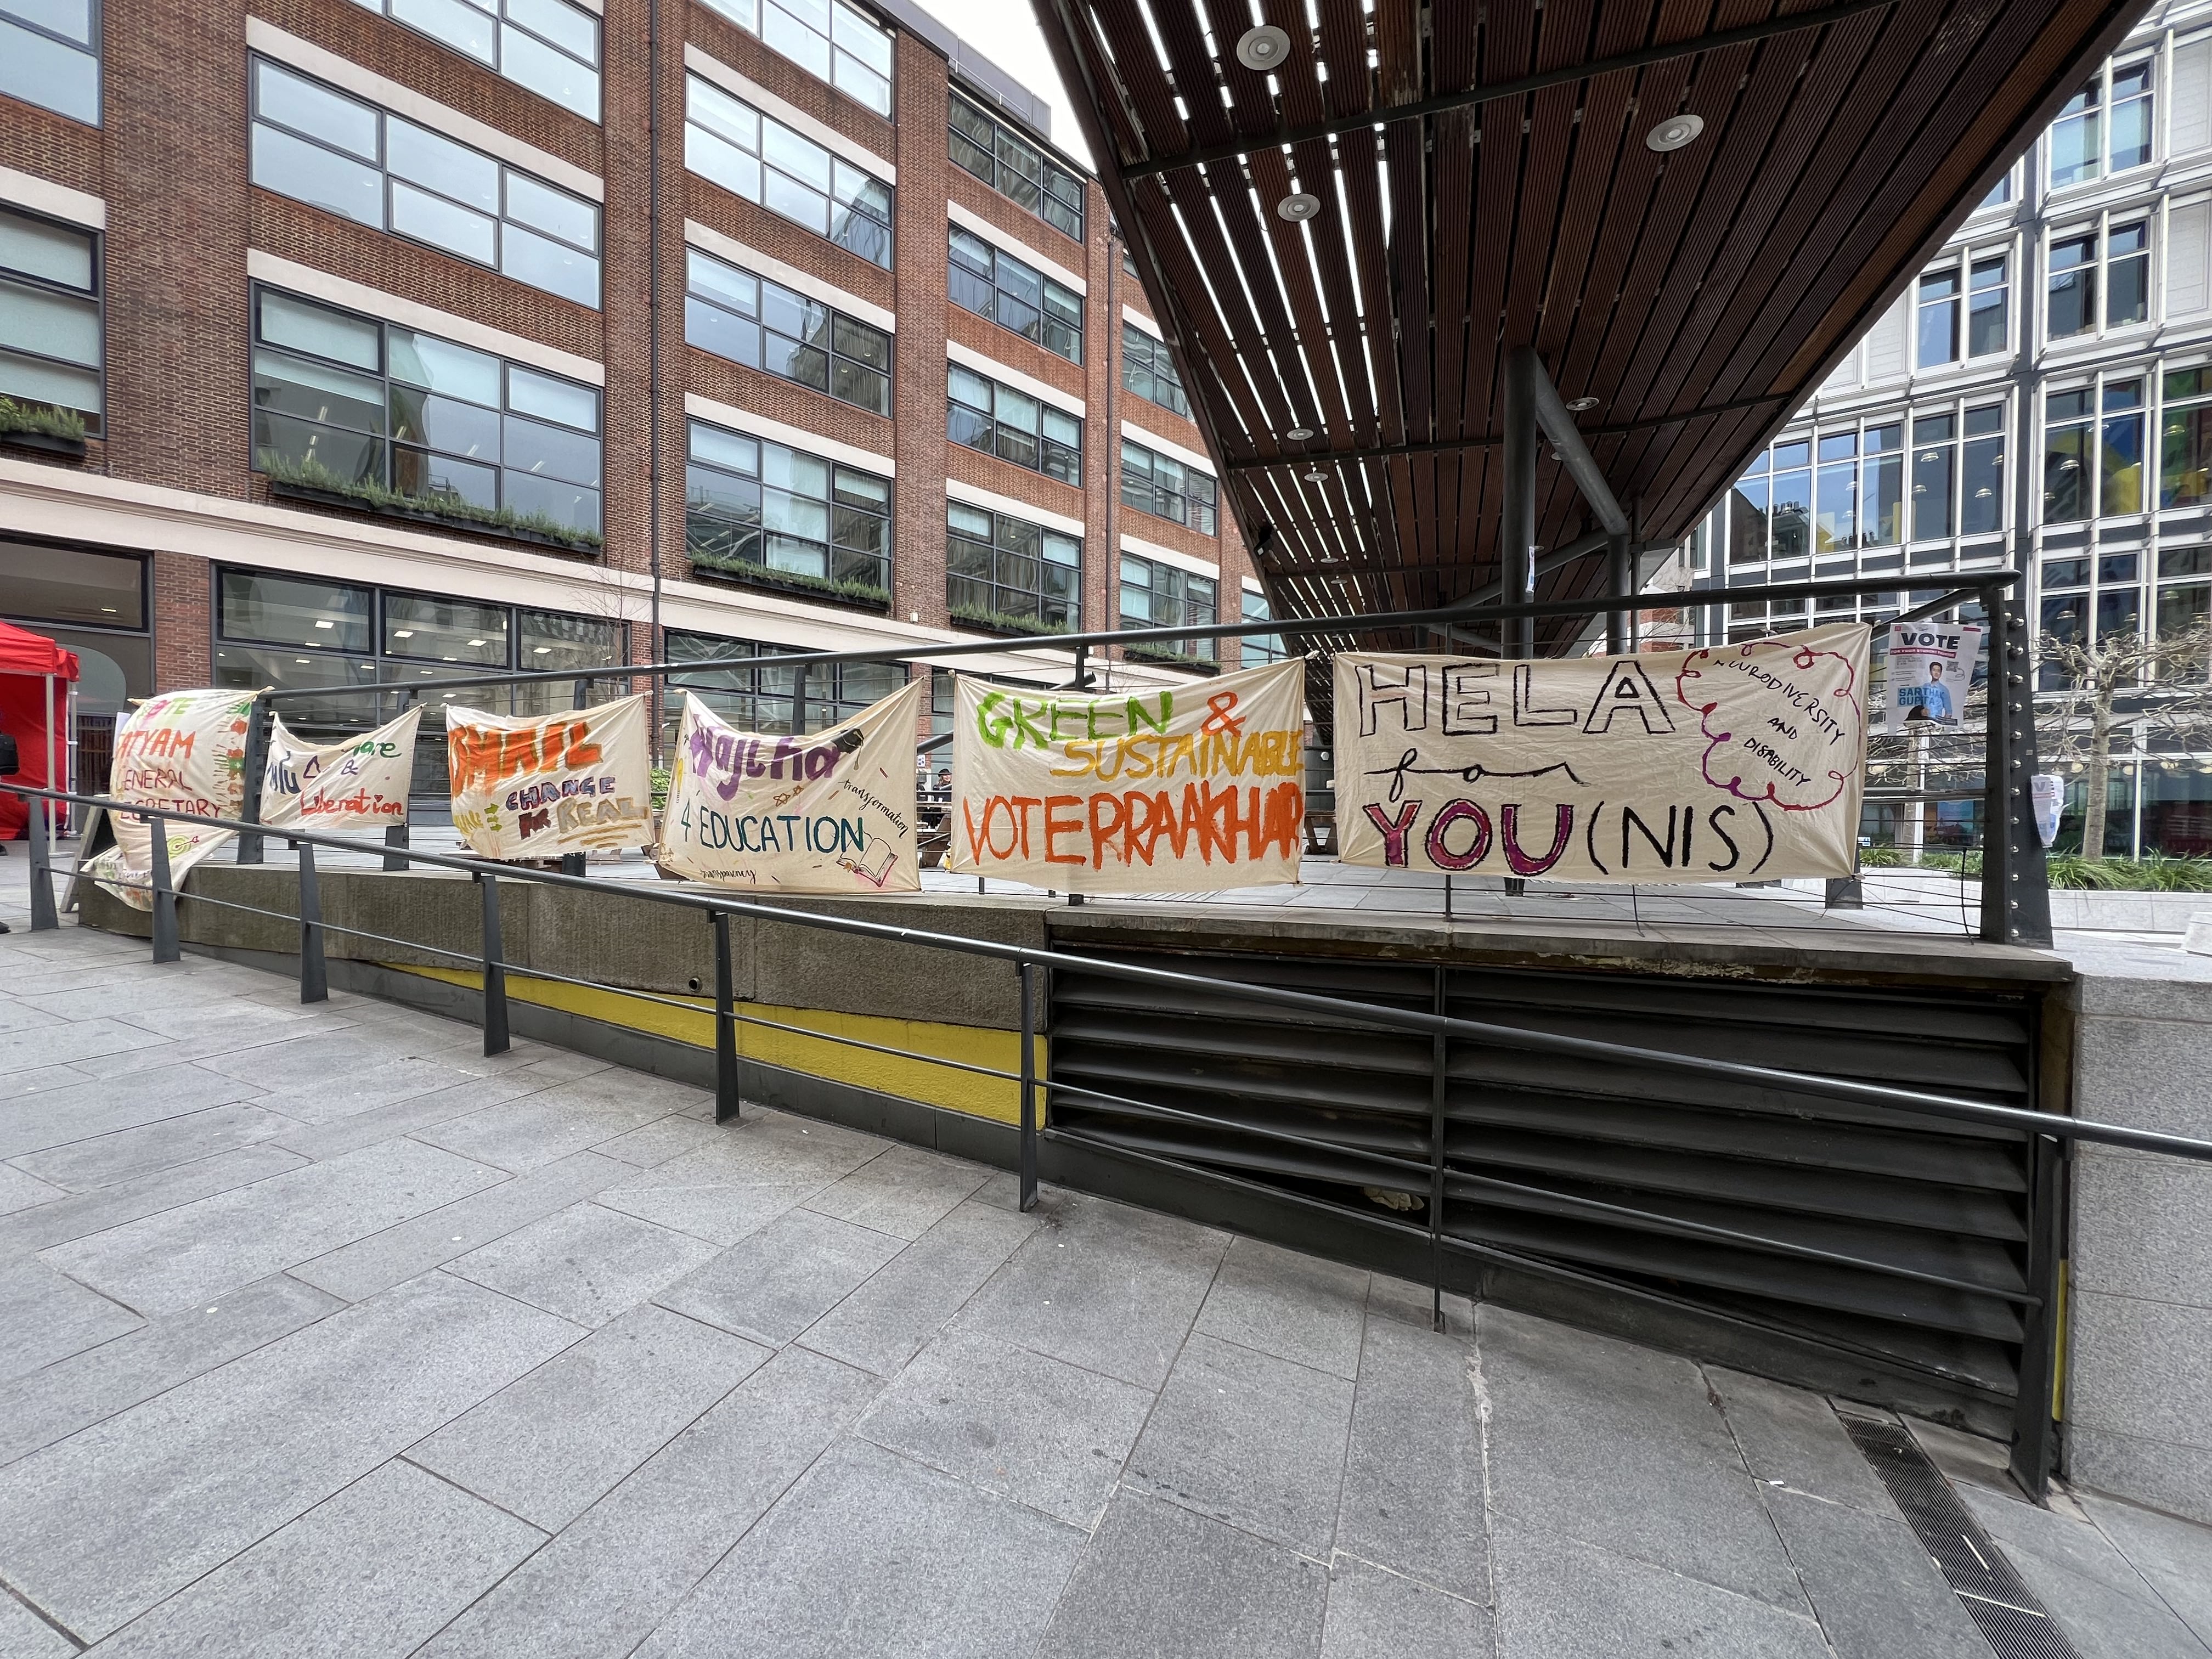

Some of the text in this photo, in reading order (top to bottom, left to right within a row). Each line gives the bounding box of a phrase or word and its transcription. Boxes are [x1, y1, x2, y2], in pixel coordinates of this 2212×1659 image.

[1901, 633, 1961, 650] VOTE
[977, 691, 1246, 750] GREEN &
[1355, 660, 1675, 737] HELA
[1899, 696, 1935, 706] GUPTA
[1767, 716, 1797, 740] AND
[1049, 730, 1304, 782] SUSTAINABLE
[1743, 737, 1811, 787] DISABILITY
[505, 776, 616, 811] CHANGE
[557, 797, 648, 833] REAL
[838, 778, 909, 839] transformation
[681, 798, 864, 853] 4 EDUCATION
[963, 794, 1087, 866] VOTE
